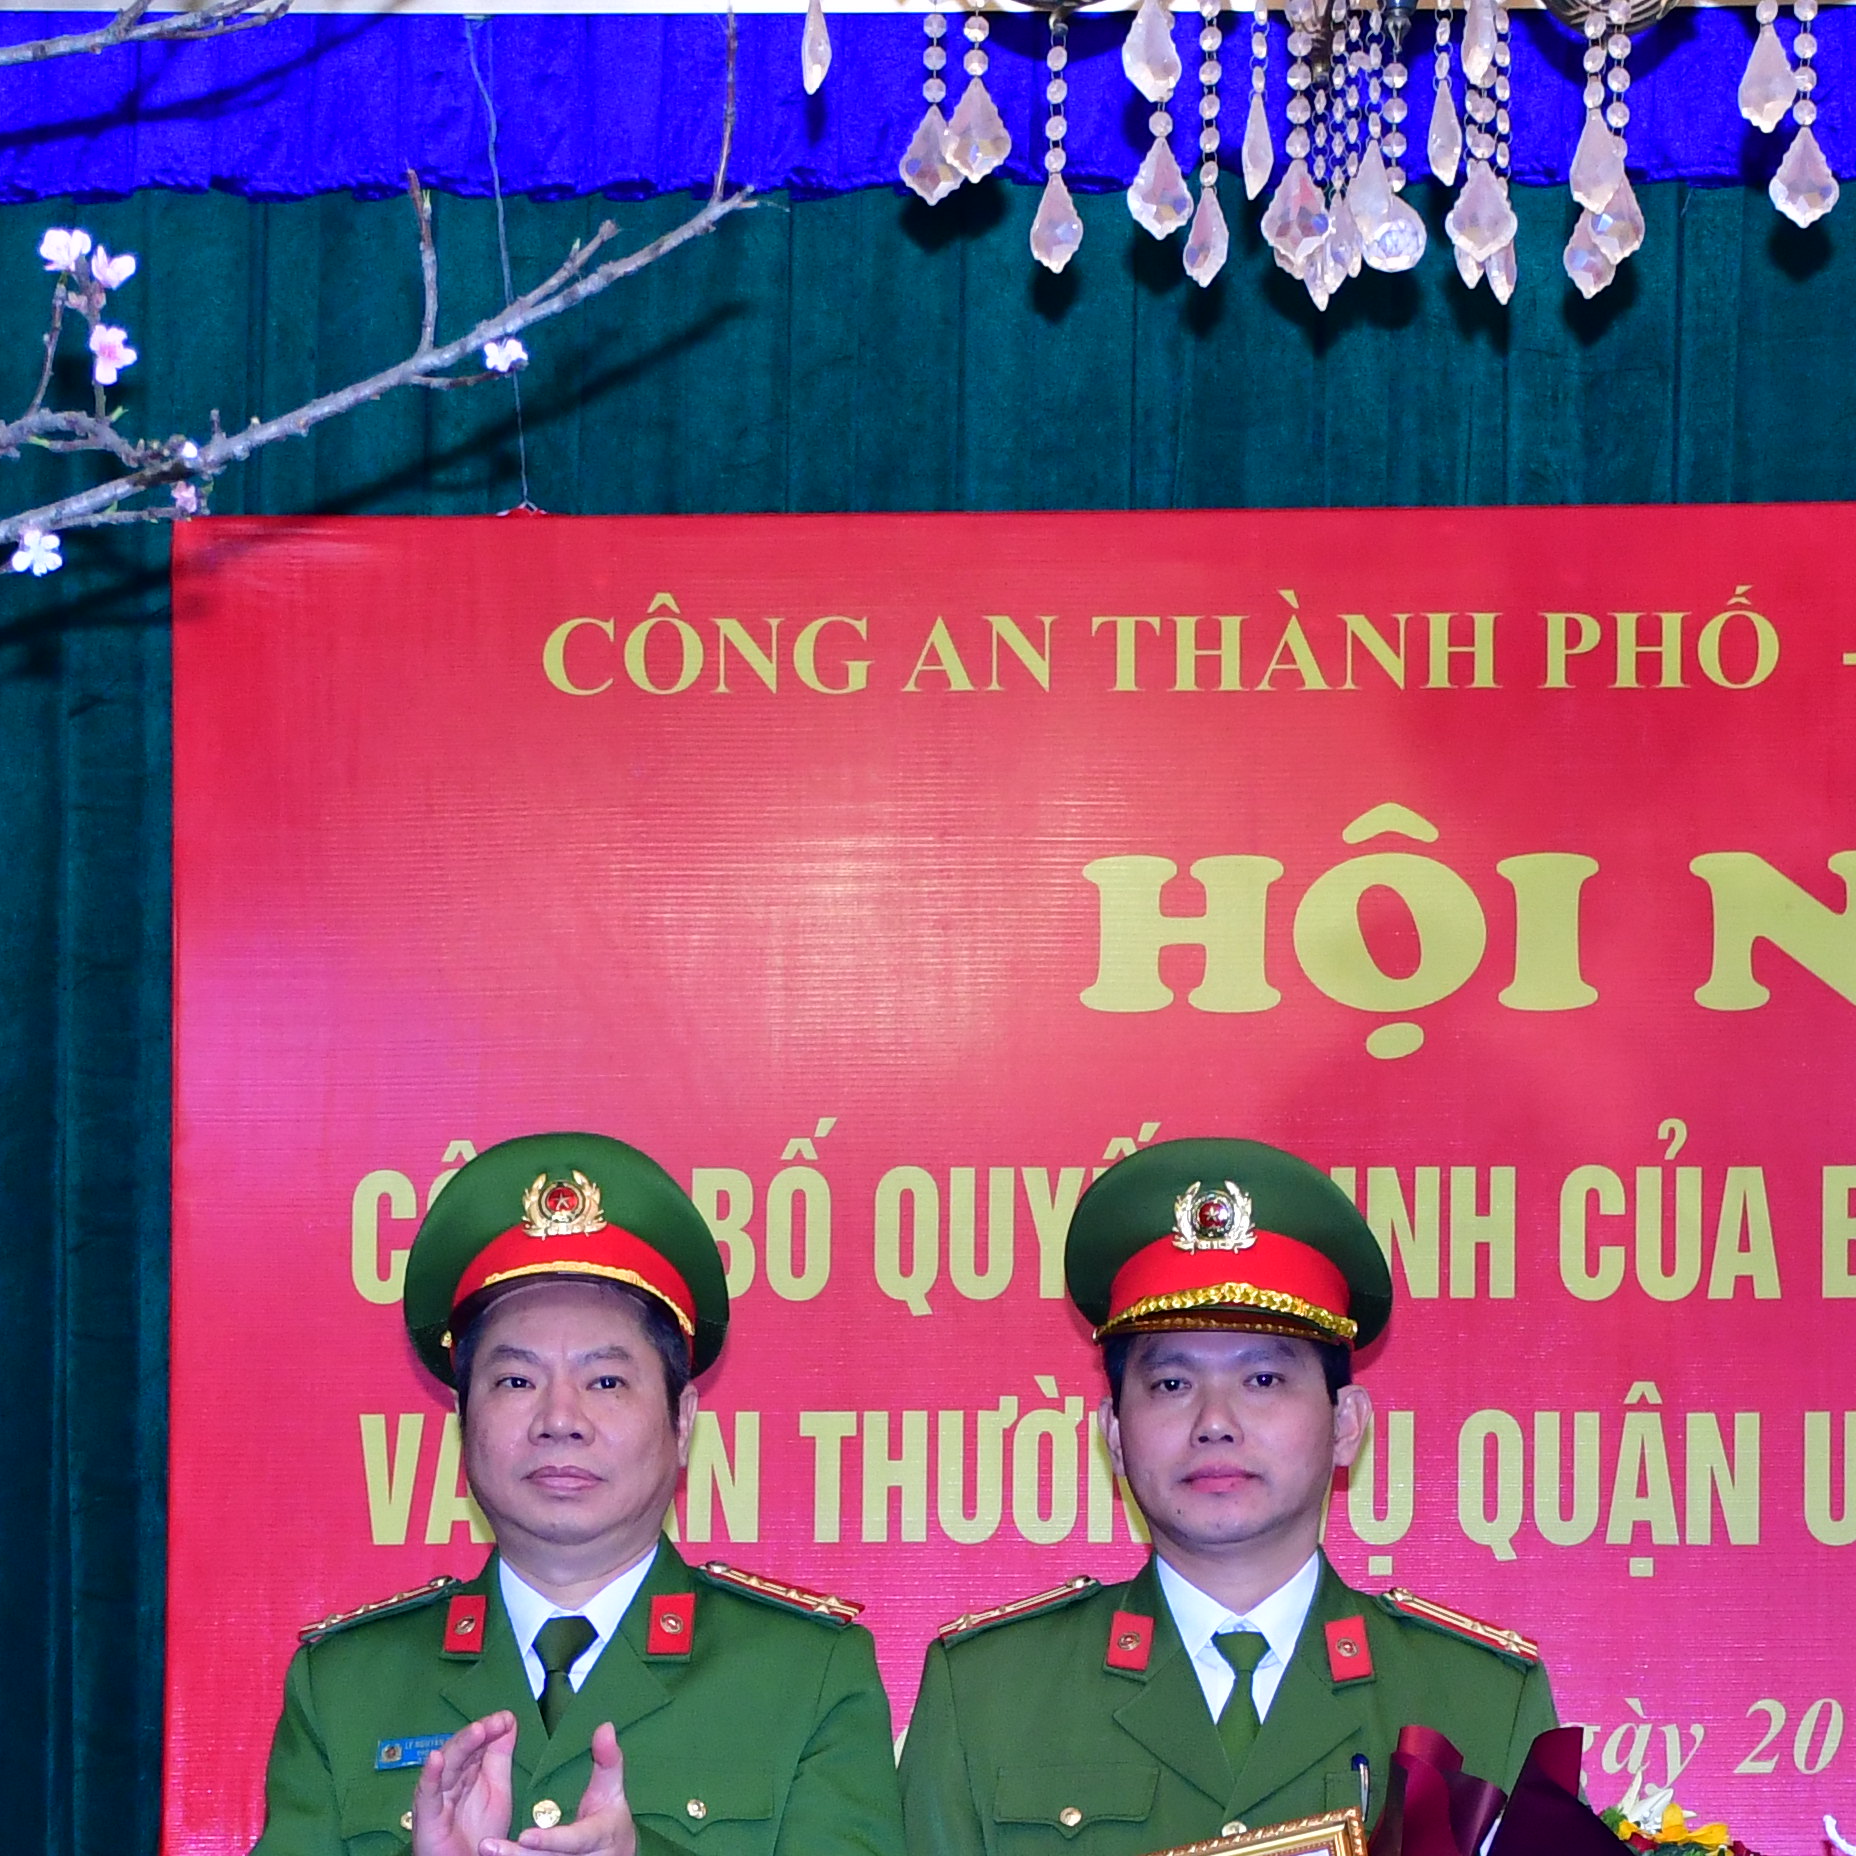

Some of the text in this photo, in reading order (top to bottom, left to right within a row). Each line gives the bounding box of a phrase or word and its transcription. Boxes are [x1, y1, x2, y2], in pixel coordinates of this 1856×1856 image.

[542, 592, 871, 696] CÔNG
[903, 615, 1055, 693] AN
[1091, 590, 1496, 692] THÀNH
[1540, 584, 1781, 689] PHỐ
[1079, 801, 1600, 1061] HỘI
[691, 1117, 839, 1303] BỐ
[874, 1122, 1162, 1317] QUY
[1559, 1118, 1782, 1302] CỦA
[1456, 1381, 1761, 1578] QUẬN
[1732, 1697, 1845, 1776] 20
